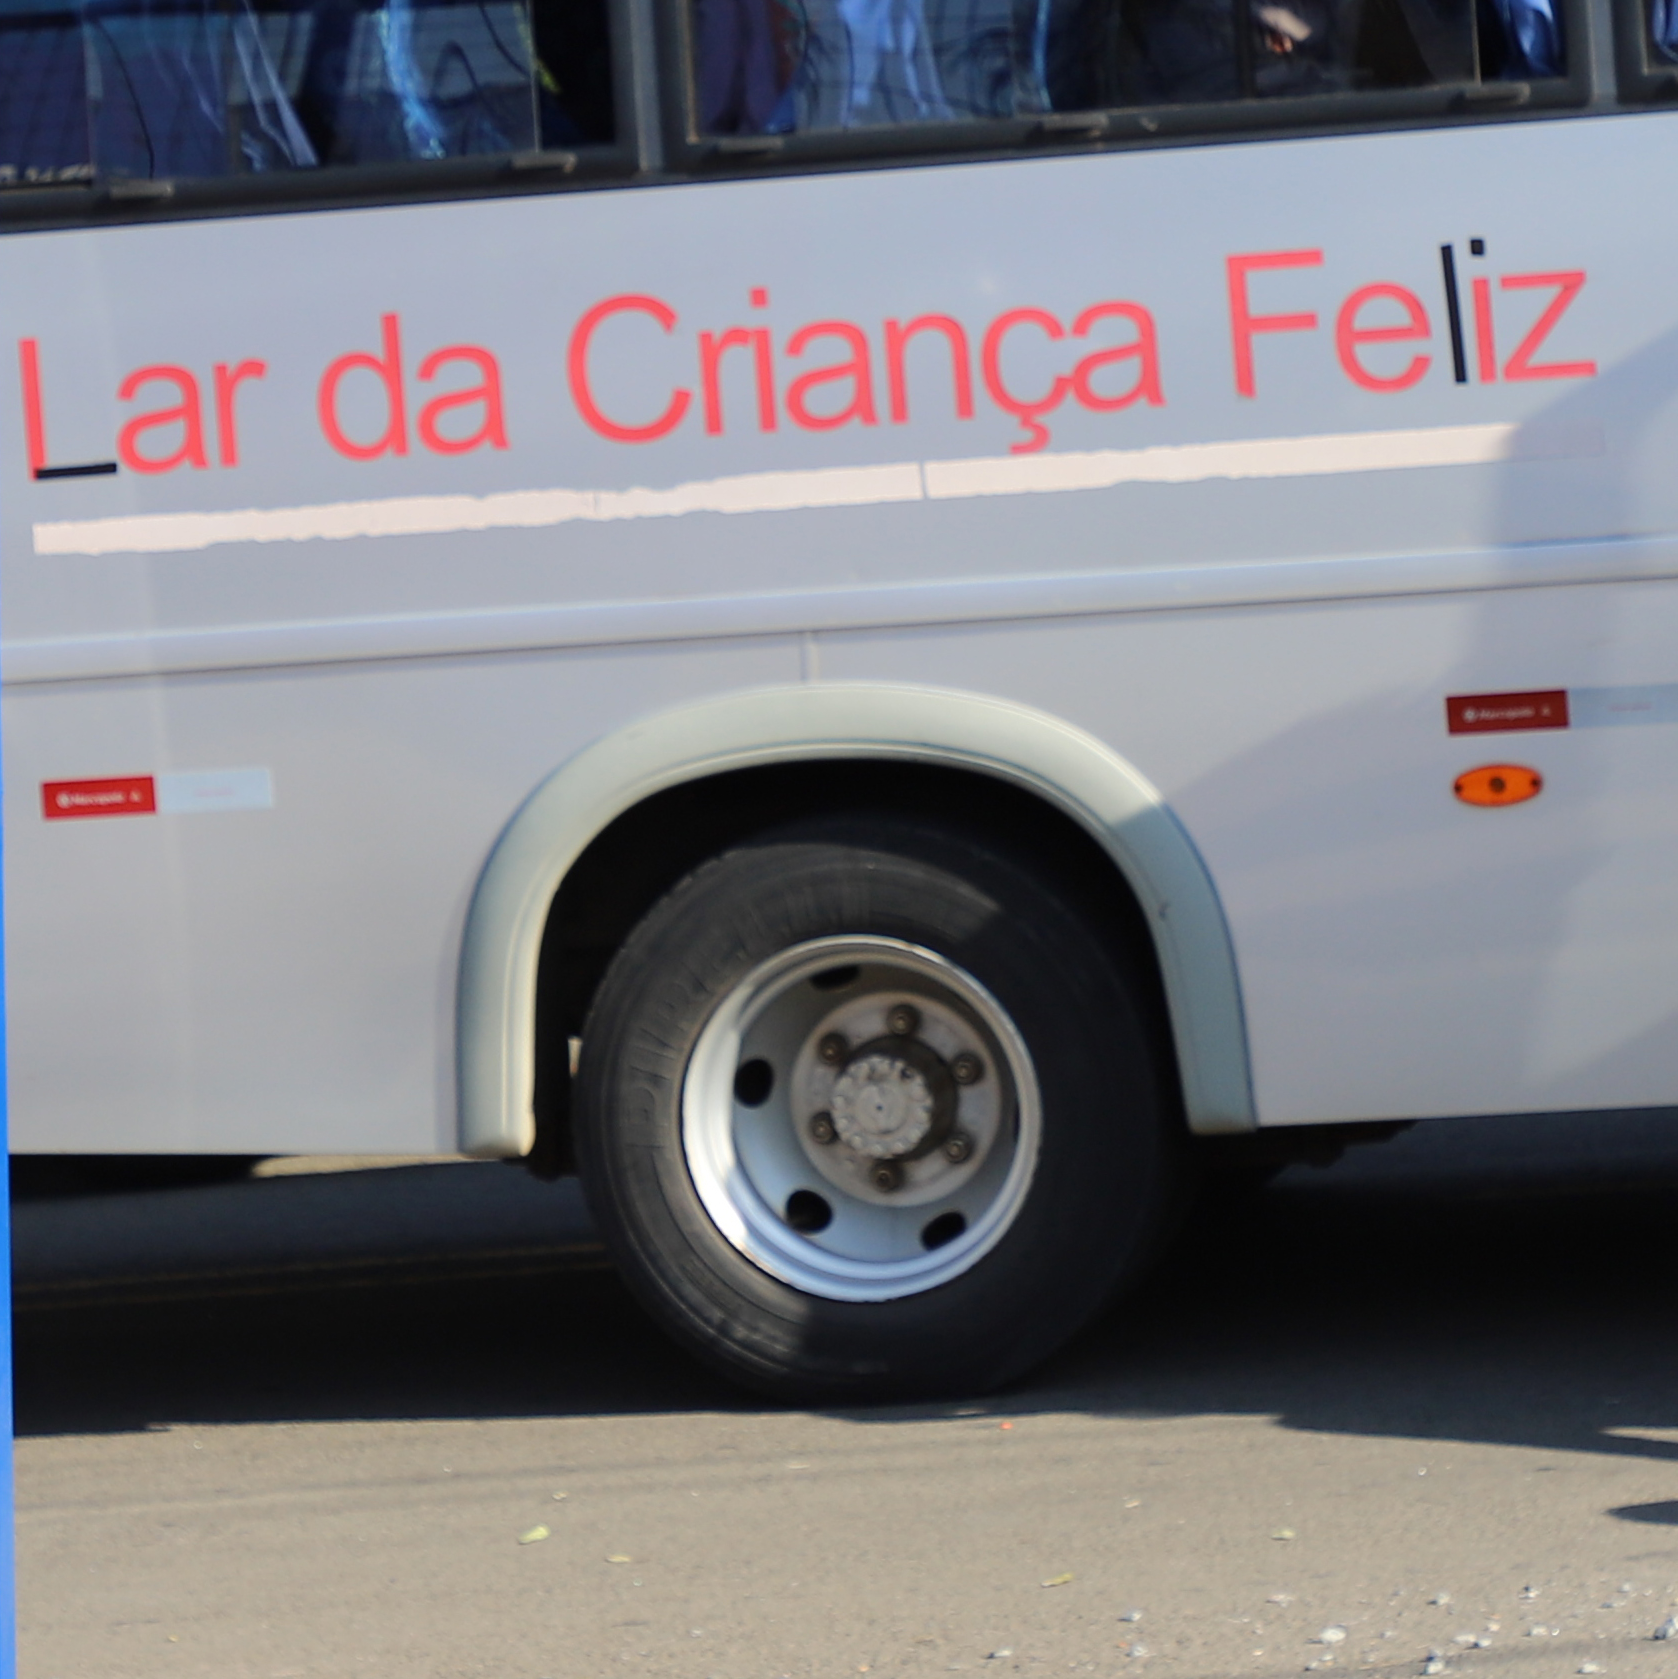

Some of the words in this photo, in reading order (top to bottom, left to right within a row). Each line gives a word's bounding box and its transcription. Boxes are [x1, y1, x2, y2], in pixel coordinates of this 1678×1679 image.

[18, 337, 269, 481] Lar
[317, 311, 511, 462] da
[566, 286, 1167, 456] Criança
[1225, 238, 1599, 399] Feliz
